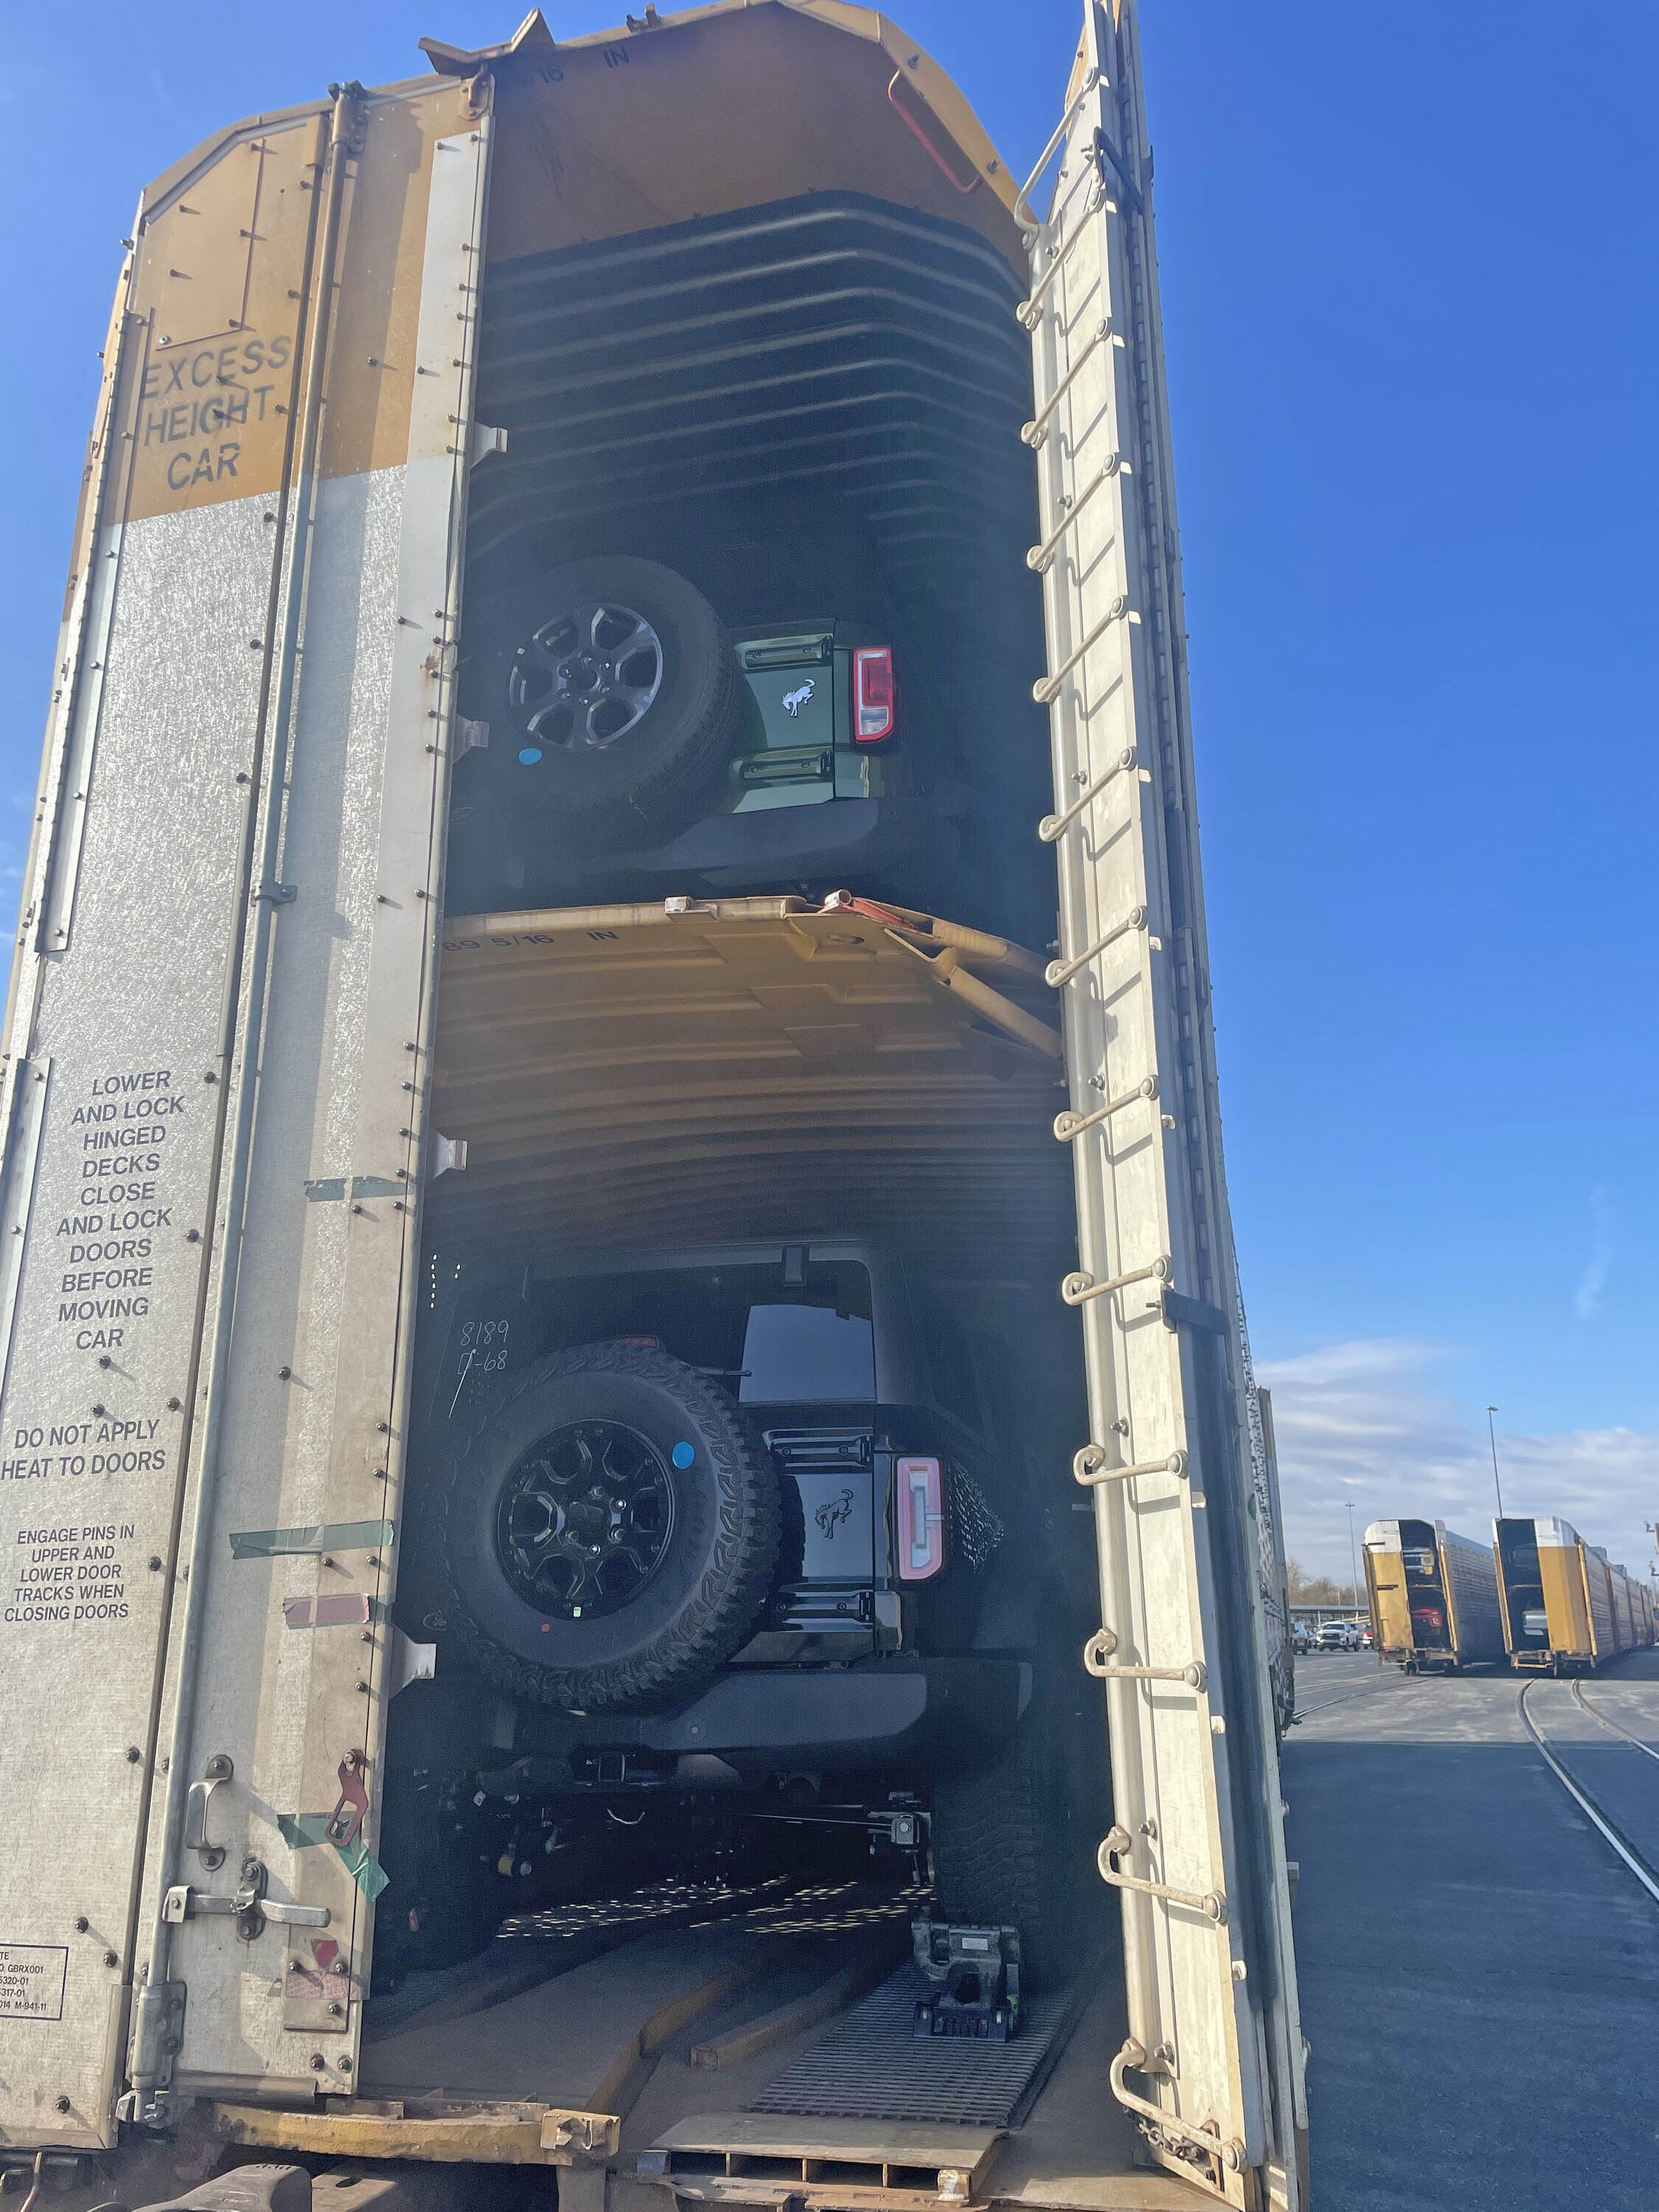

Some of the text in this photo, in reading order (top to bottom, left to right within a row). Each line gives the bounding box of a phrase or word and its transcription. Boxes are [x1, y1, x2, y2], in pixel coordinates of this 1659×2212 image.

[602, 46, 630, 69] IN
[142, 335, 291, 399] EXCESS
[145, 385, 275, 447] HEIGHT
[167, 443, 240, 490] CAR
[491, 934, 554, 947] 5/16
[587, 931, 619, 941] IN
[92, 1071, 171, 1096] LOWER
[72, 1096, 186, 1124] AND LOCK
[83, 1125, 166, 1150] HINGED
[83, 1152, 160, 1178] DECKS
[80, 1181, 156, 1206] CLOSE
[56, 1208, 173, 1236] AND LOCK
[69, 1239, 152, 1263] DOORS
[61, 1267, 153, 1293] BEFORE
[58, 1297, 148, 1322] MOVING
[76, 1329, 124, 1349] CAR
[460, 1321, 509, 1346] 8189
[15, 1419, 160, 1448] DO NOT APPLY
[1, 1450, 166, 1480] HEAT TO DOORS
[18, 1524, 135, 1544] ENGAGE PINS IN
[32, 1545, 114, 1562] UPPER AND
[20, 1565, 122, 1582] LOWER DOOR
[14, 1584, 124, 1601] TRACKS WHEN
[4, 1604, 129, 1621] CLOSING DOORS
[7, 1964, 44, 1974] GBRX001
[0, 1988, 25, 1997] 317-01
[15, 2001, 47, 2011] M-941-11
